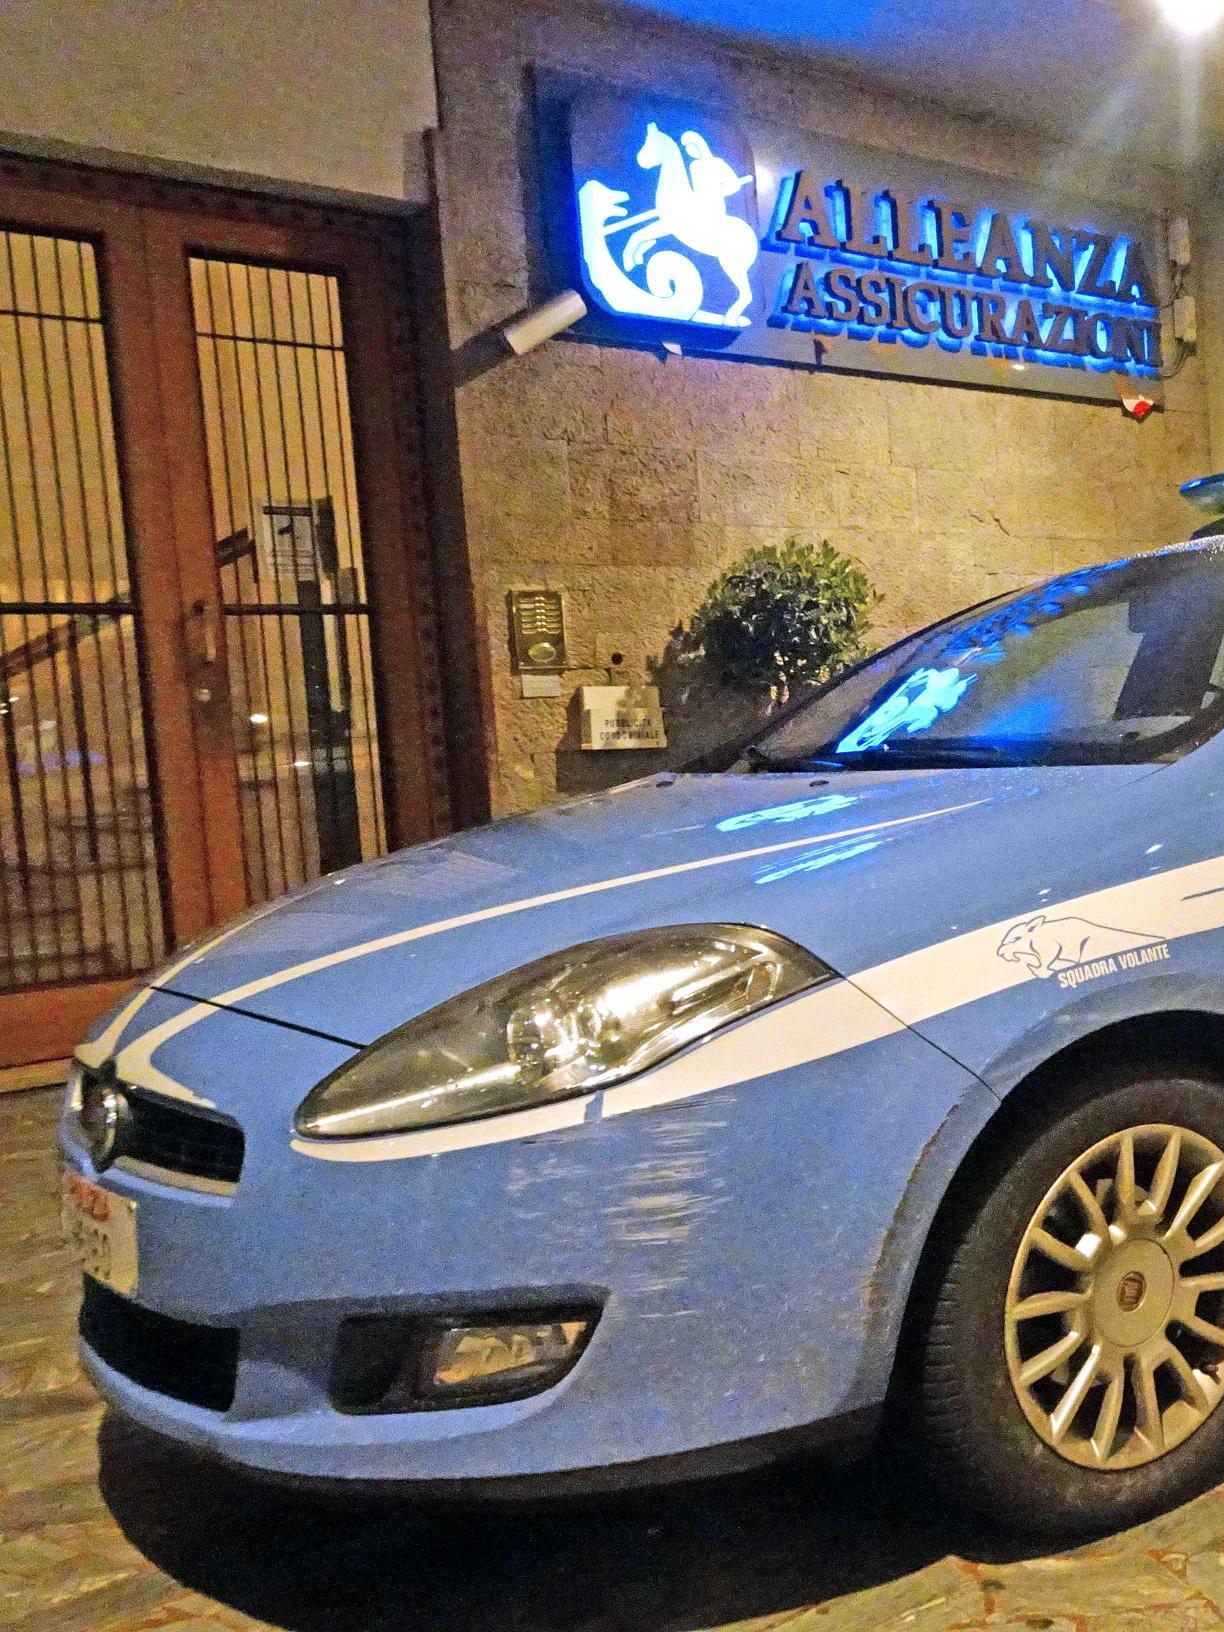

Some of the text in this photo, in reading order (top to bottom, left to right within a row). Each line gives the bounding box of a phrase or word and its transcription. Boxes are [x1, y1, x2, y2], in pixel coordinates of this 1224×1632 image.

[773, 168, 1157, 309] ALLEANZA
[780, 259, 1164, 368] ASSICURAZIONI
[1058, 944, 1170, 988] SQUADRA VOLANTE
